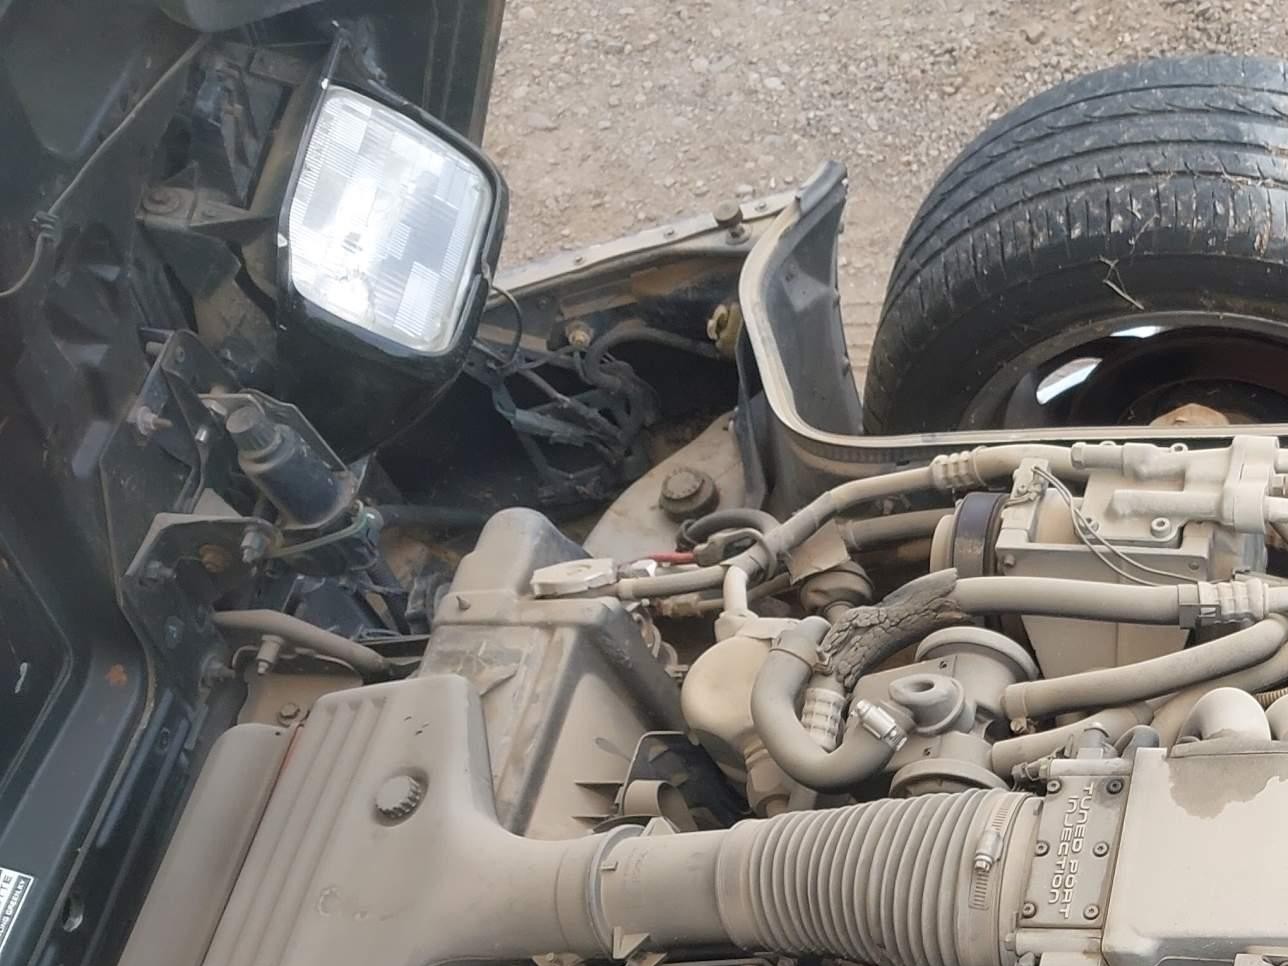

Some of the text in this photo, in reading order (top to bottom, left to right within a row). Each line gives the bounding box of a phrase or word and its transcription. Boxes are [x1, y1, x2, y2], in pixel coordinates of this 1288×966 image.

[1048, 795, 1080, 905] INJECTION
[1059, 783, 1094, 919] TUNED PORT
